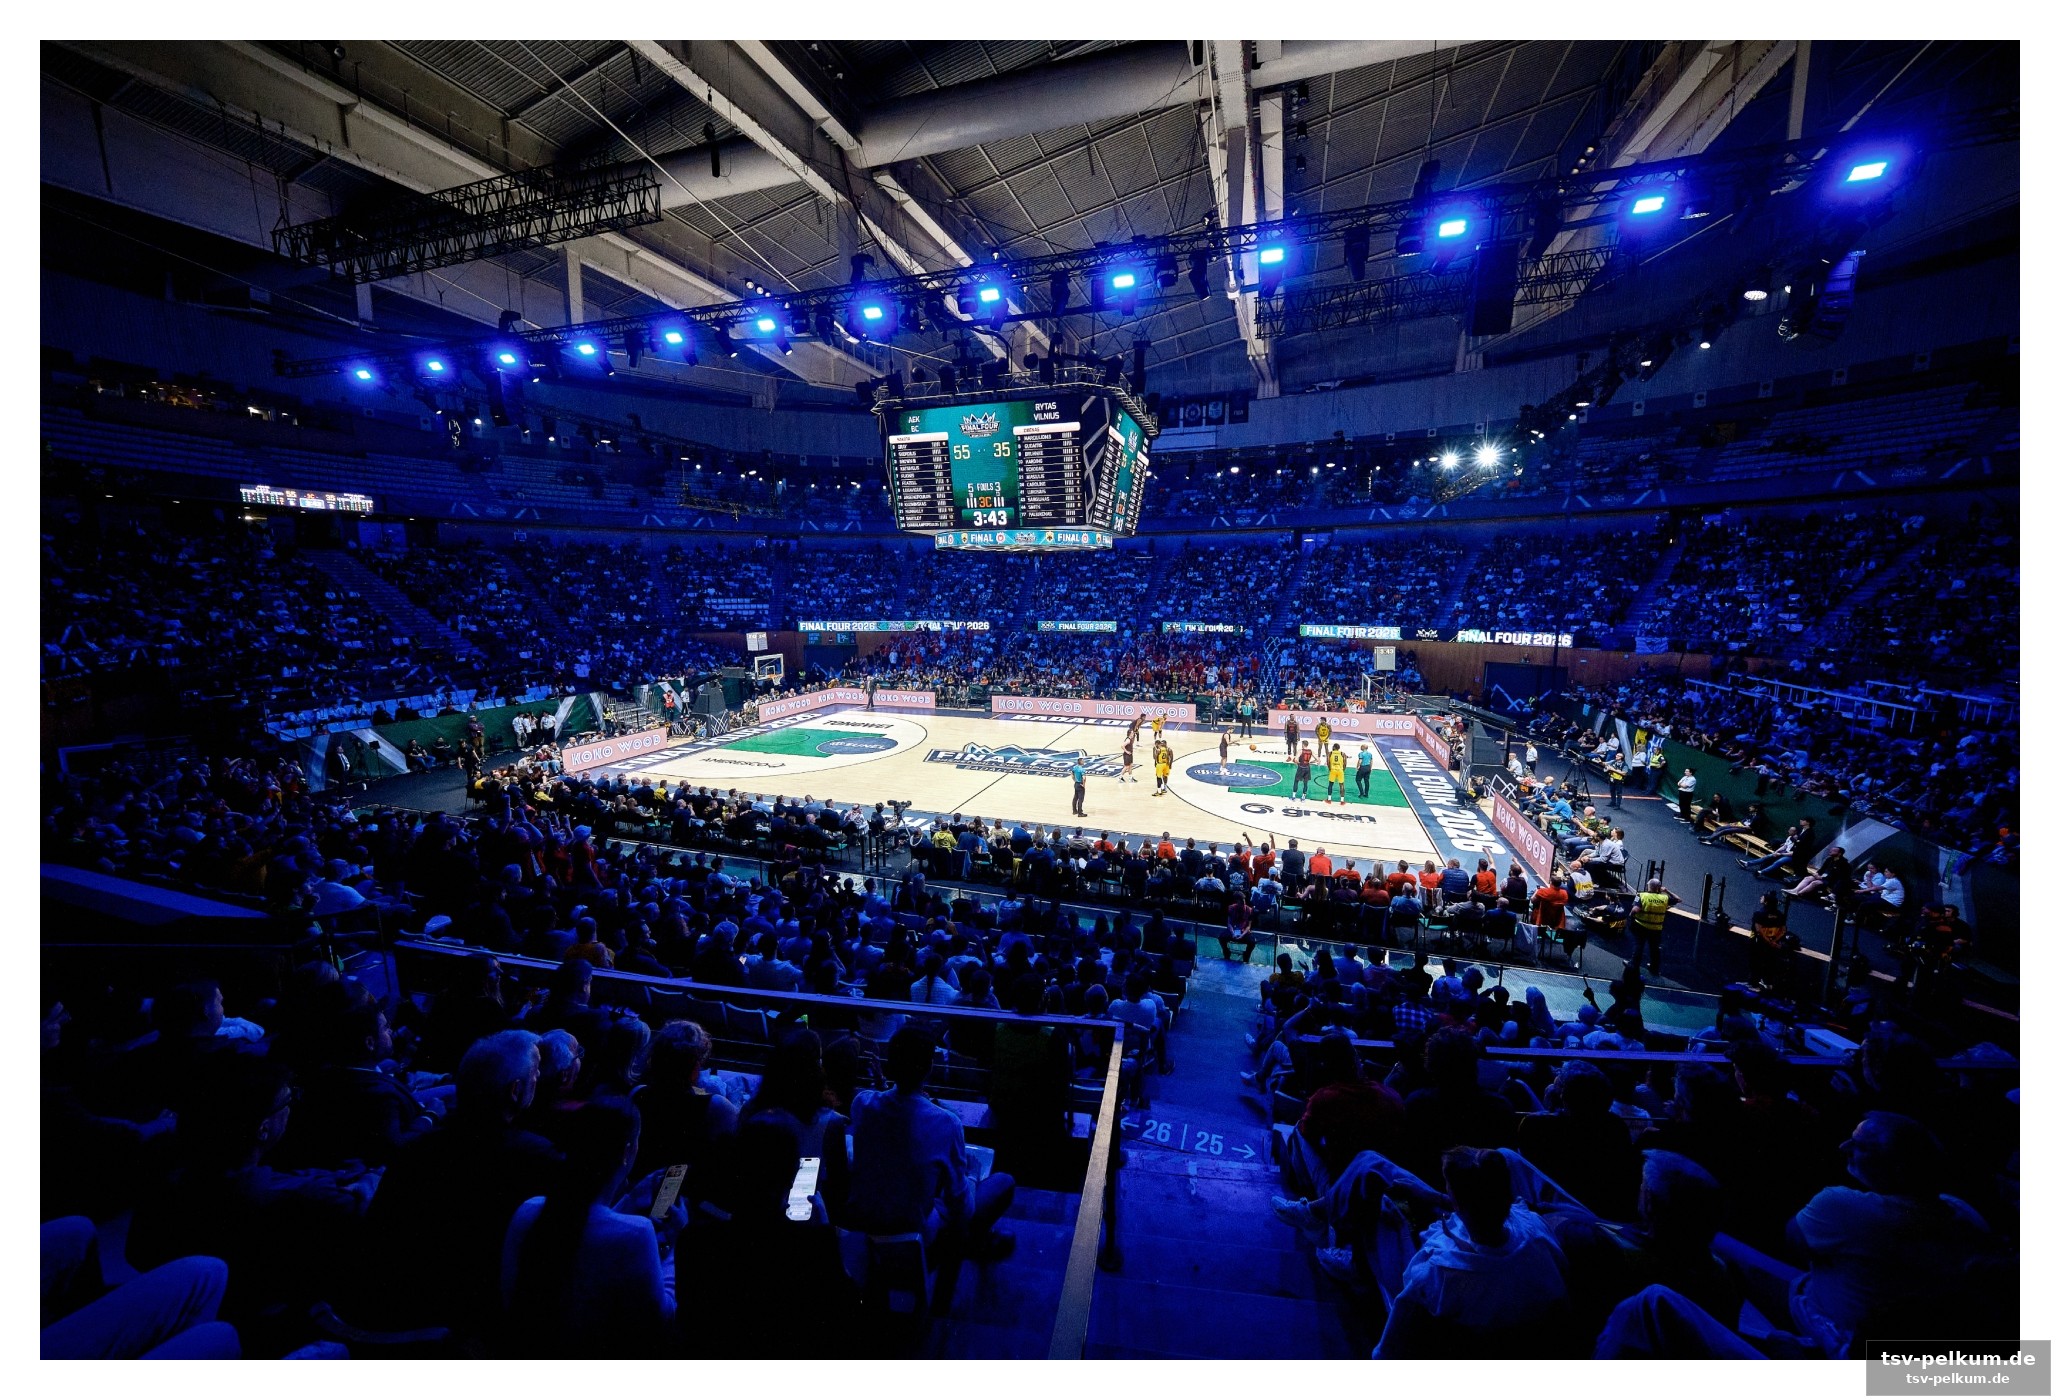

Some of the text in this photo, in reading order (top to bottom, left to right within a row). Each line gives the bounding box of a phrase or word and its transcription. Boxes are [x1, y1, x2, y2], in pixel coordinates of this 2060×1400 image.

[1035, 402, 1057, 411] RYTAS
[1033, 412, 1060, 421] VILNIUS
[953, 444, 971, 460] 55
[993, 442, 1011, 457] 35
[968, 482, 1001, 492] 5 FOULS 3
[979, 496, 992, 508] 3C
[973, 510, 1008, 527] 3:43
[971, 534, 993, 542] FINAL
[1058, 534, 1079, 542] FINAL
[800, 622, 875, 631] FINAL FOUR 2026
[967, 622, 990, 630] 2026
[1306, 626, 1398, 639] FINAL FOUR 2026
[1458, 630, 1572, 646] FINAL FOUR 2026
[817, 691, 864, 704] KOKO WOOD
[873, 692, 931, 704] KOKO WOOD
[765, 697, 811, 717] KOKO WOOD
[998, 699, 1082, 713] KOKO WOOD
[1096, 703, 1188, 718] KOKO WOOD
[1376, 719, 1413, 730] KOKO
[571, 734, 661, 766] KOKO WOOD
[936, 751, 1024, 766] FINAL
[1391, 748, 1440, 774] FINAL
[1429, 807, 1507, 855] 2026
[1282, 808, 1377, 823] green
[1496, 802, 1547, 866] KOKO WOOD
[1142, 1119, 1224, 1155] 26 25
